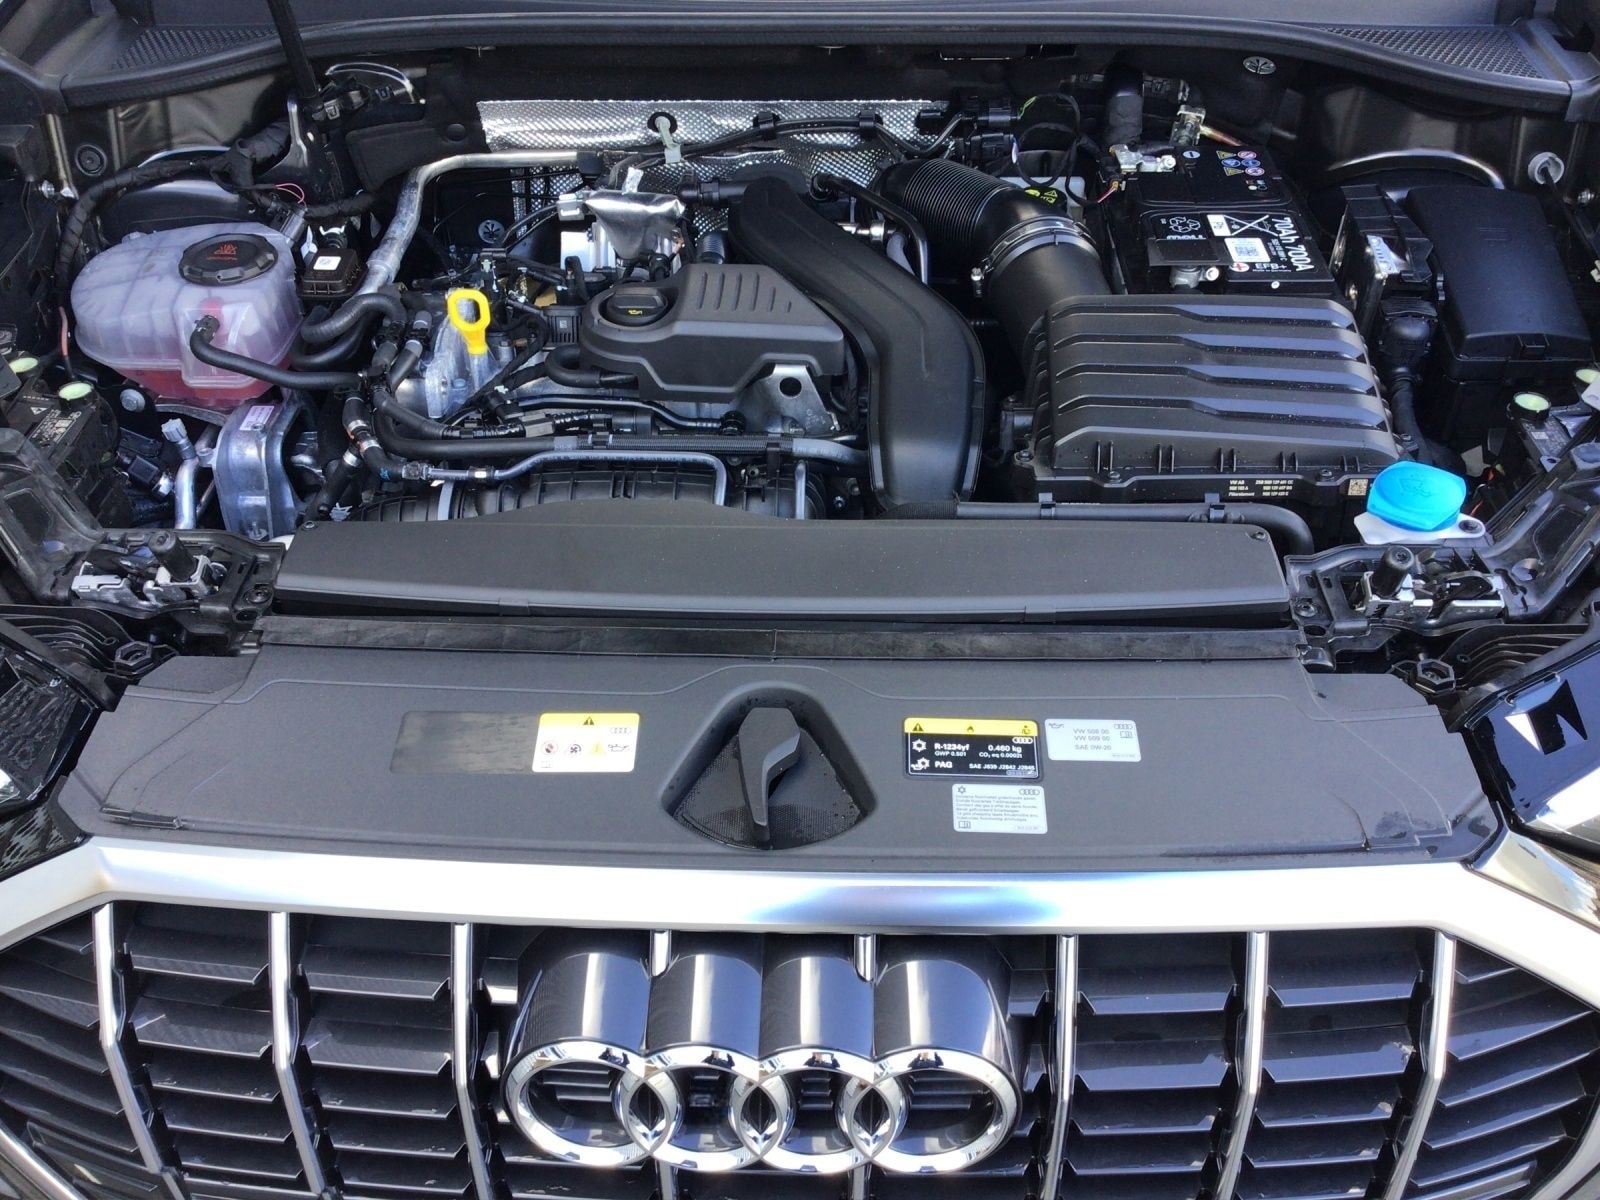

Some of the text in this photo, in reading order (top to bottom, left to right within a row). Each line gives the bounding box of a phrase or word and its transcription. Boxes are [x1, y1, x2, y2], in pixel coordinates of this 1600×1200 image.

[1272, 217, 1300, 243] 70Ah
[1285, 244, 1315, 271] 700A
[934, 743, 970, 752] R-1234yf
[1011, 745, 1022, 753] kg
[934, 761, 953, 769] PAG
